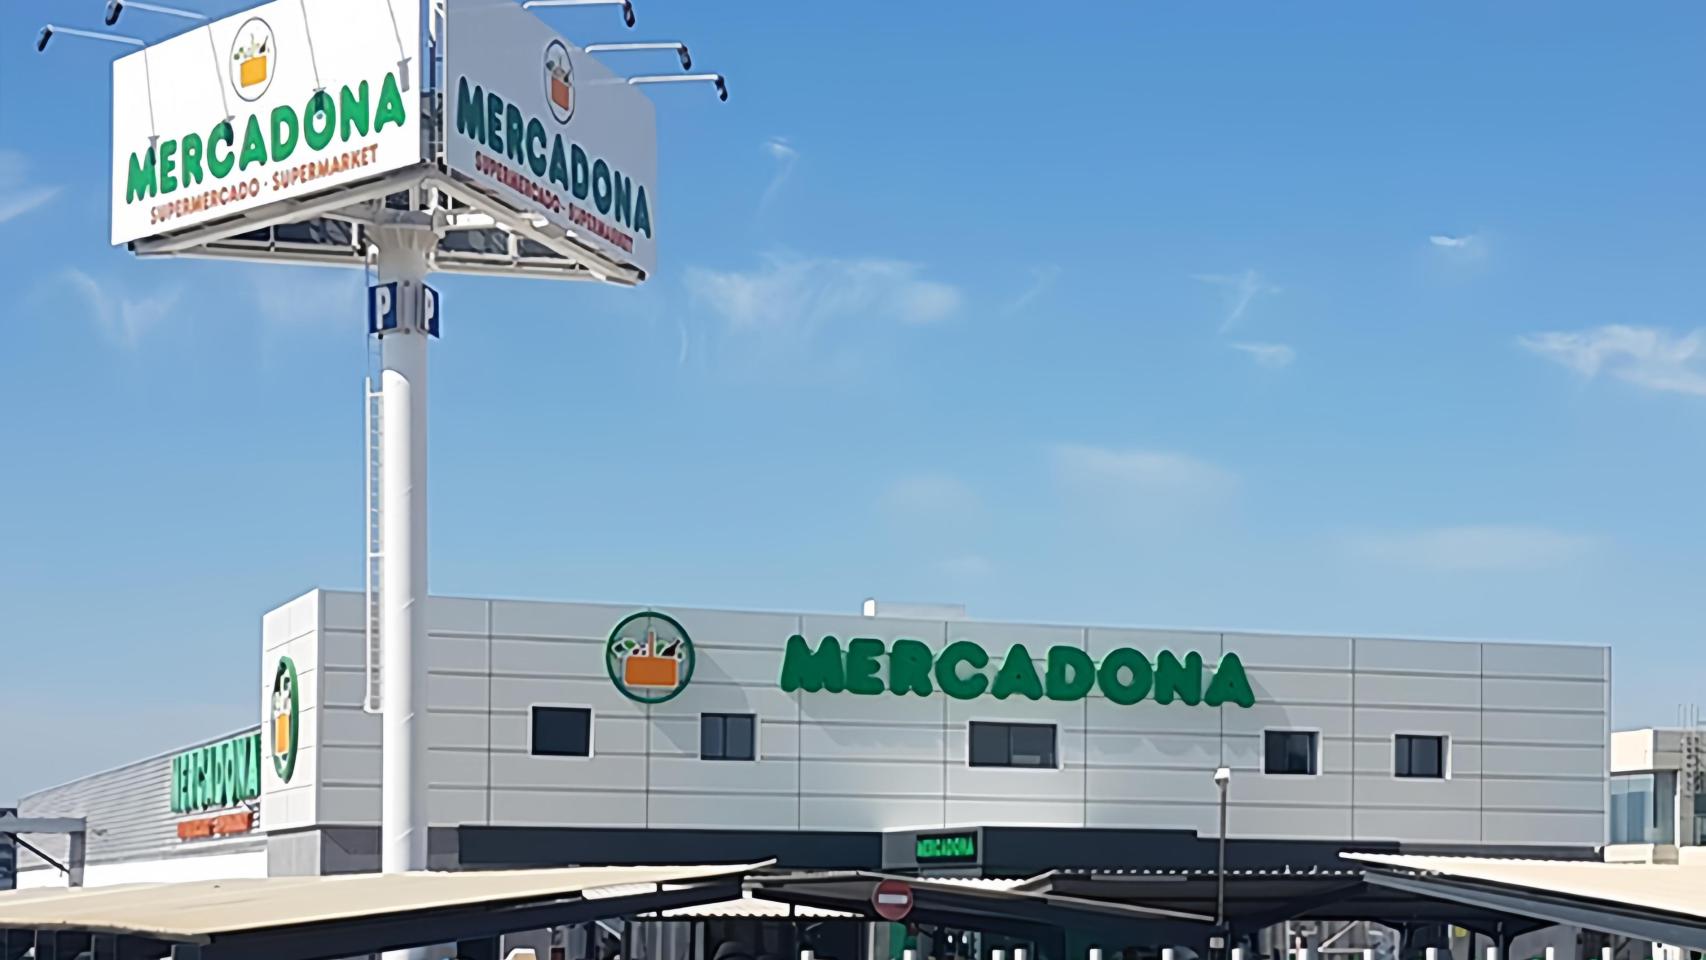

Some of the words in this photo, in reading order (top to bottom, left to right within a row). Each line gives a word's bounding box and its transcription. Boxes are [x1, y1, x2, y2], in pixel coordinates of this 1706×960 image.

[126, 71, 406, 204] MERCADONA
[457, 76, 651, 239] MERCADONA
[150, 177, 260, 225] SUPERMERCADO
[272, 143, 378, 191] SUPERMARKET
[375, 285, 391, 330] P
[424, 287, 435, 330] P
[782, 634, 1256, 708] MERCADONA
